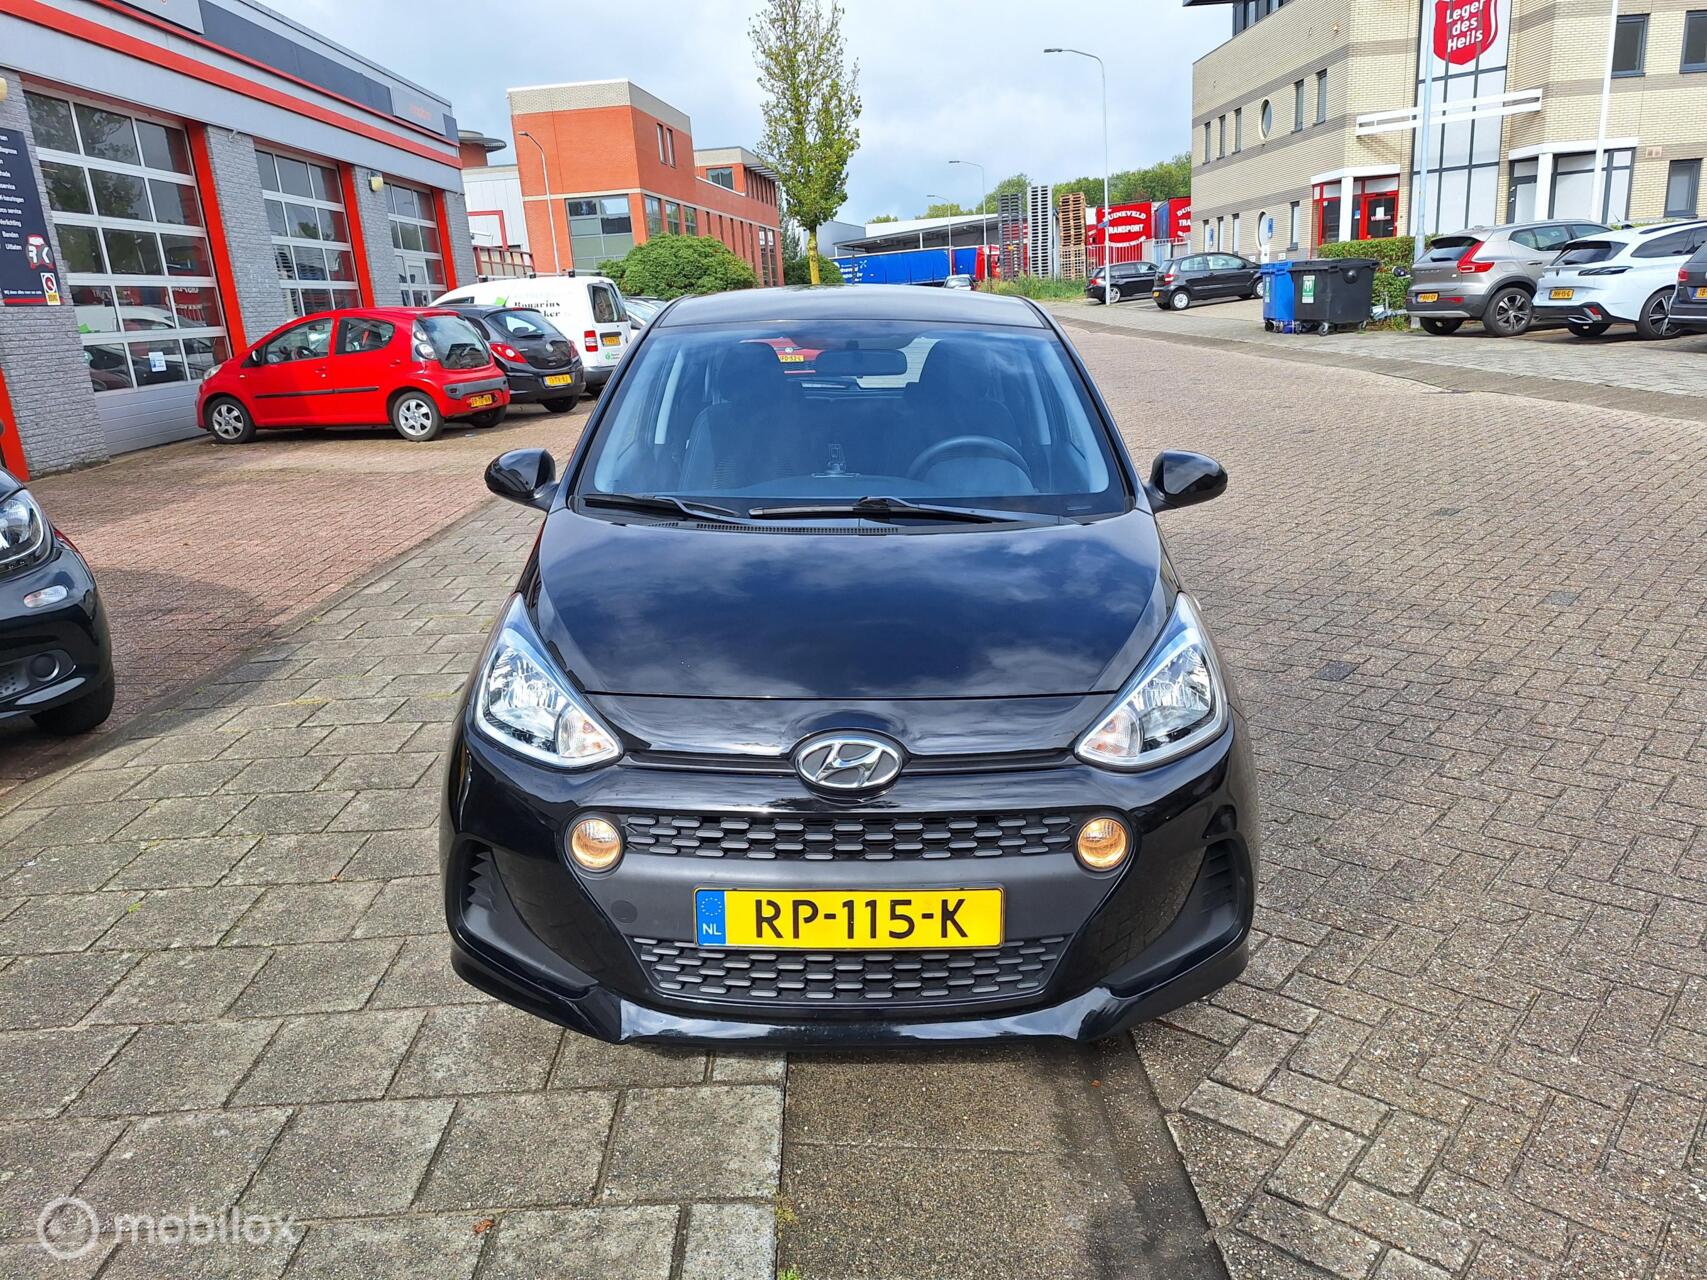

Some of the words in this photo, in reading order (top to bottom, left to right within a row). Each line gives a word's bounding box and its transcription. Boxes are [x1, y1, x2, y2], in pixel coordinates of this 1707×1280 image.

[1446, 0, 1485, 23] Leger
[1452, 17, 1478, 36] des
[1447, 30, 1483, 53] Heils
[1103, 210, 1147, 222] UINEVELD
[1107, 223, 1145, 234] RANSPORT
[543, 310, 560, 318] ker
[702, 922, 722, 936] NL
[755, 899, 969, 939] RP-115-K
